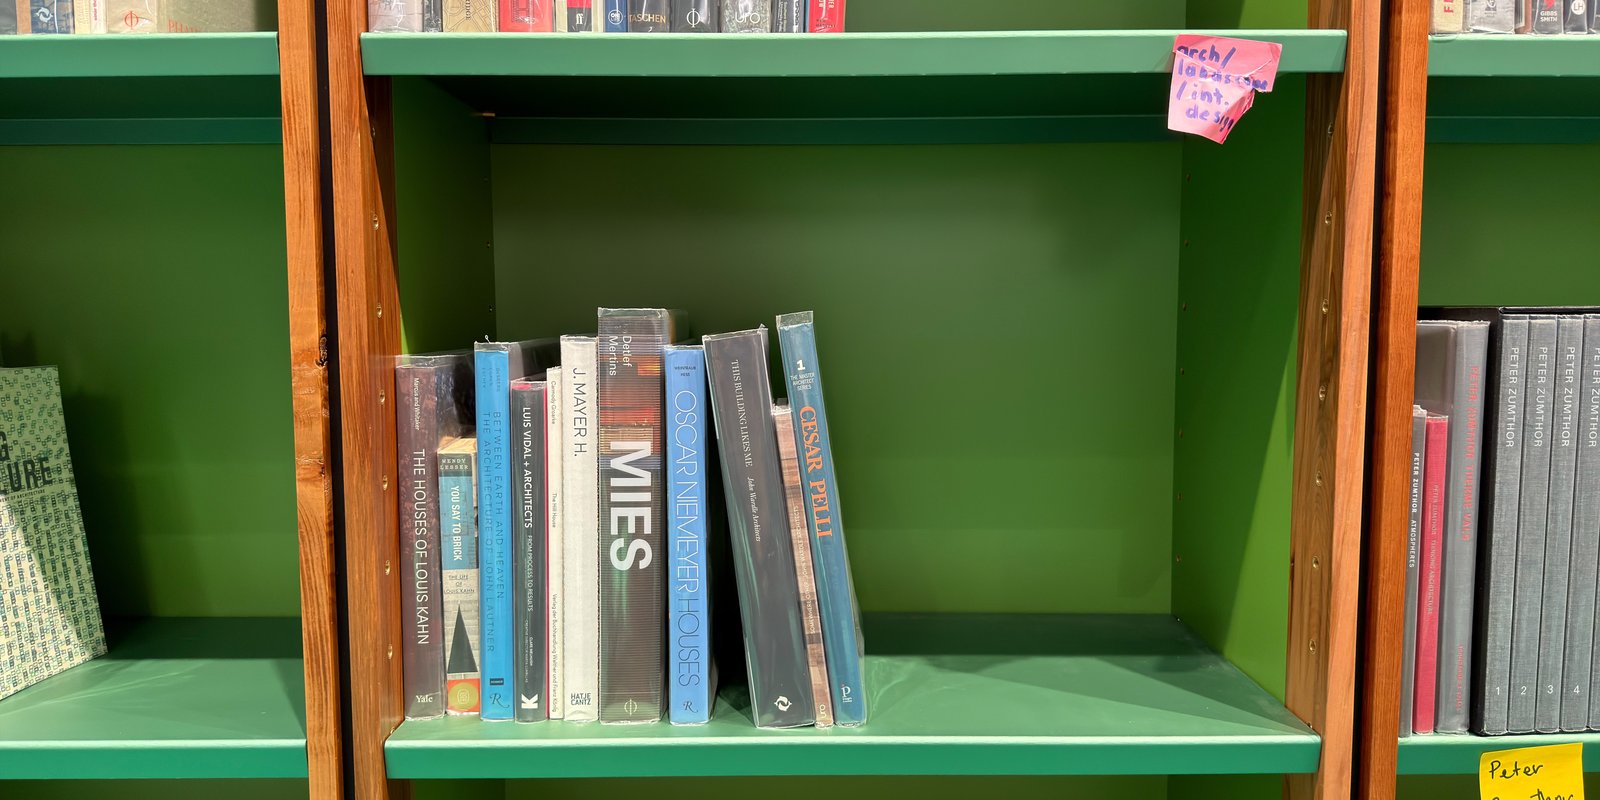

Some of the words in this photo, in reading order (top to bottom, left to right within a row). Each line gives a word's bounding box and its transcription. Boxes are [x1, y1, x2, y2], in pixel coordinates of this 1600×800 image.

[628, 13, 667, 24] TASCHEN
[608, 335, 619, 376] Mertins
[622, 335, 632, 367] Detlef
[796, 359, 806, 370] 1
[1509, 347, 1520, 384] PETER
[1538, 346, 1548, 383] PETER
[1565, 346, 1576, 383] PETER
[572, 368, 586, 379] J.
[731, 359, 742, 381] THIS
[1468, 366, 1479, 402] PETER
[522, 407, 531, 428] LUIS
[574, 383, 587, 437] MAYER
[734, 382, 747, 425] BUILDING
[1506, 388, 1517, 447] ZUMTHOR
[1534, 388, 1546, 447] ZUMTHOR
[1562, 388, 1573, 447] ZUMTHOR
[1589, 388, 1600, 448] ZUMTHOR
[483, 412, 491, 433] THE
[674, 390, 698, 476] OSCAR
[1466, 406, 1477, 459] ZUMTHOR
[493, 412, 502, 470] BETWEEN
[524, 430, 532, 459] VIDAL
[574, 443, 588, 457] H.
[740, 426, 752, 452] LIKES
[800, 405, 823, 473] CESAR
[413, 448, 426, 476] THE
[744, 452, 753, 467] ME
[450, 486, 460, 502] YOU
[484, 440, 493, 532] ARCHITECTURE
[494, 476, 503, 515] EARTH
[524, 469, 532, 528] ARCHITECTS
[746, 476, 756, 491] John
[1463, 464, 1474, 509] THERME
[414, 480, 427, 535] HOUSES
[451, 504, 460, 520] SAY
[610, 440, 652, 570] MIES
[750, 492, 758, 513] Wardle
[809, 479, 832, 540] PELLI
[452, 522, 461, 534] TO
[496, 521, 504, 546] AND
[676, 481, 699, 593] NIEMEYER
[752, 514, 762, 542] Architects
[794, 505, 802, 538] ARCHITECTS
[1462, 513, 1472, 541] VALS
[415, 539, 428, 558] OF
[452, 536, 462, 561] BRICK
[486, 538, 494, 554] OF
[1409, 519, 1417, 568] ATMOSPHERES
[416, 562, 428, 603] LOUIS
[486, 560, 494, 592] JOHN
[496, 552, 504, 599] HEAVEN
[528, 579, 533, 587] TO
[416, 606, 429, 645] KAHN
[486, 598, 495, 652] LAUTNER
[678, 598, 700, 687] HOUSES
[416, 694, 433, 703] Yale
[1496, 686, 1500, 695] 1
[1520, 685, 1527, 695] 2
[1547, 684, 1554, 694] 3
[1573, 685, 1580, 694] 4
[1489, 760, 1543, 779] Peter
